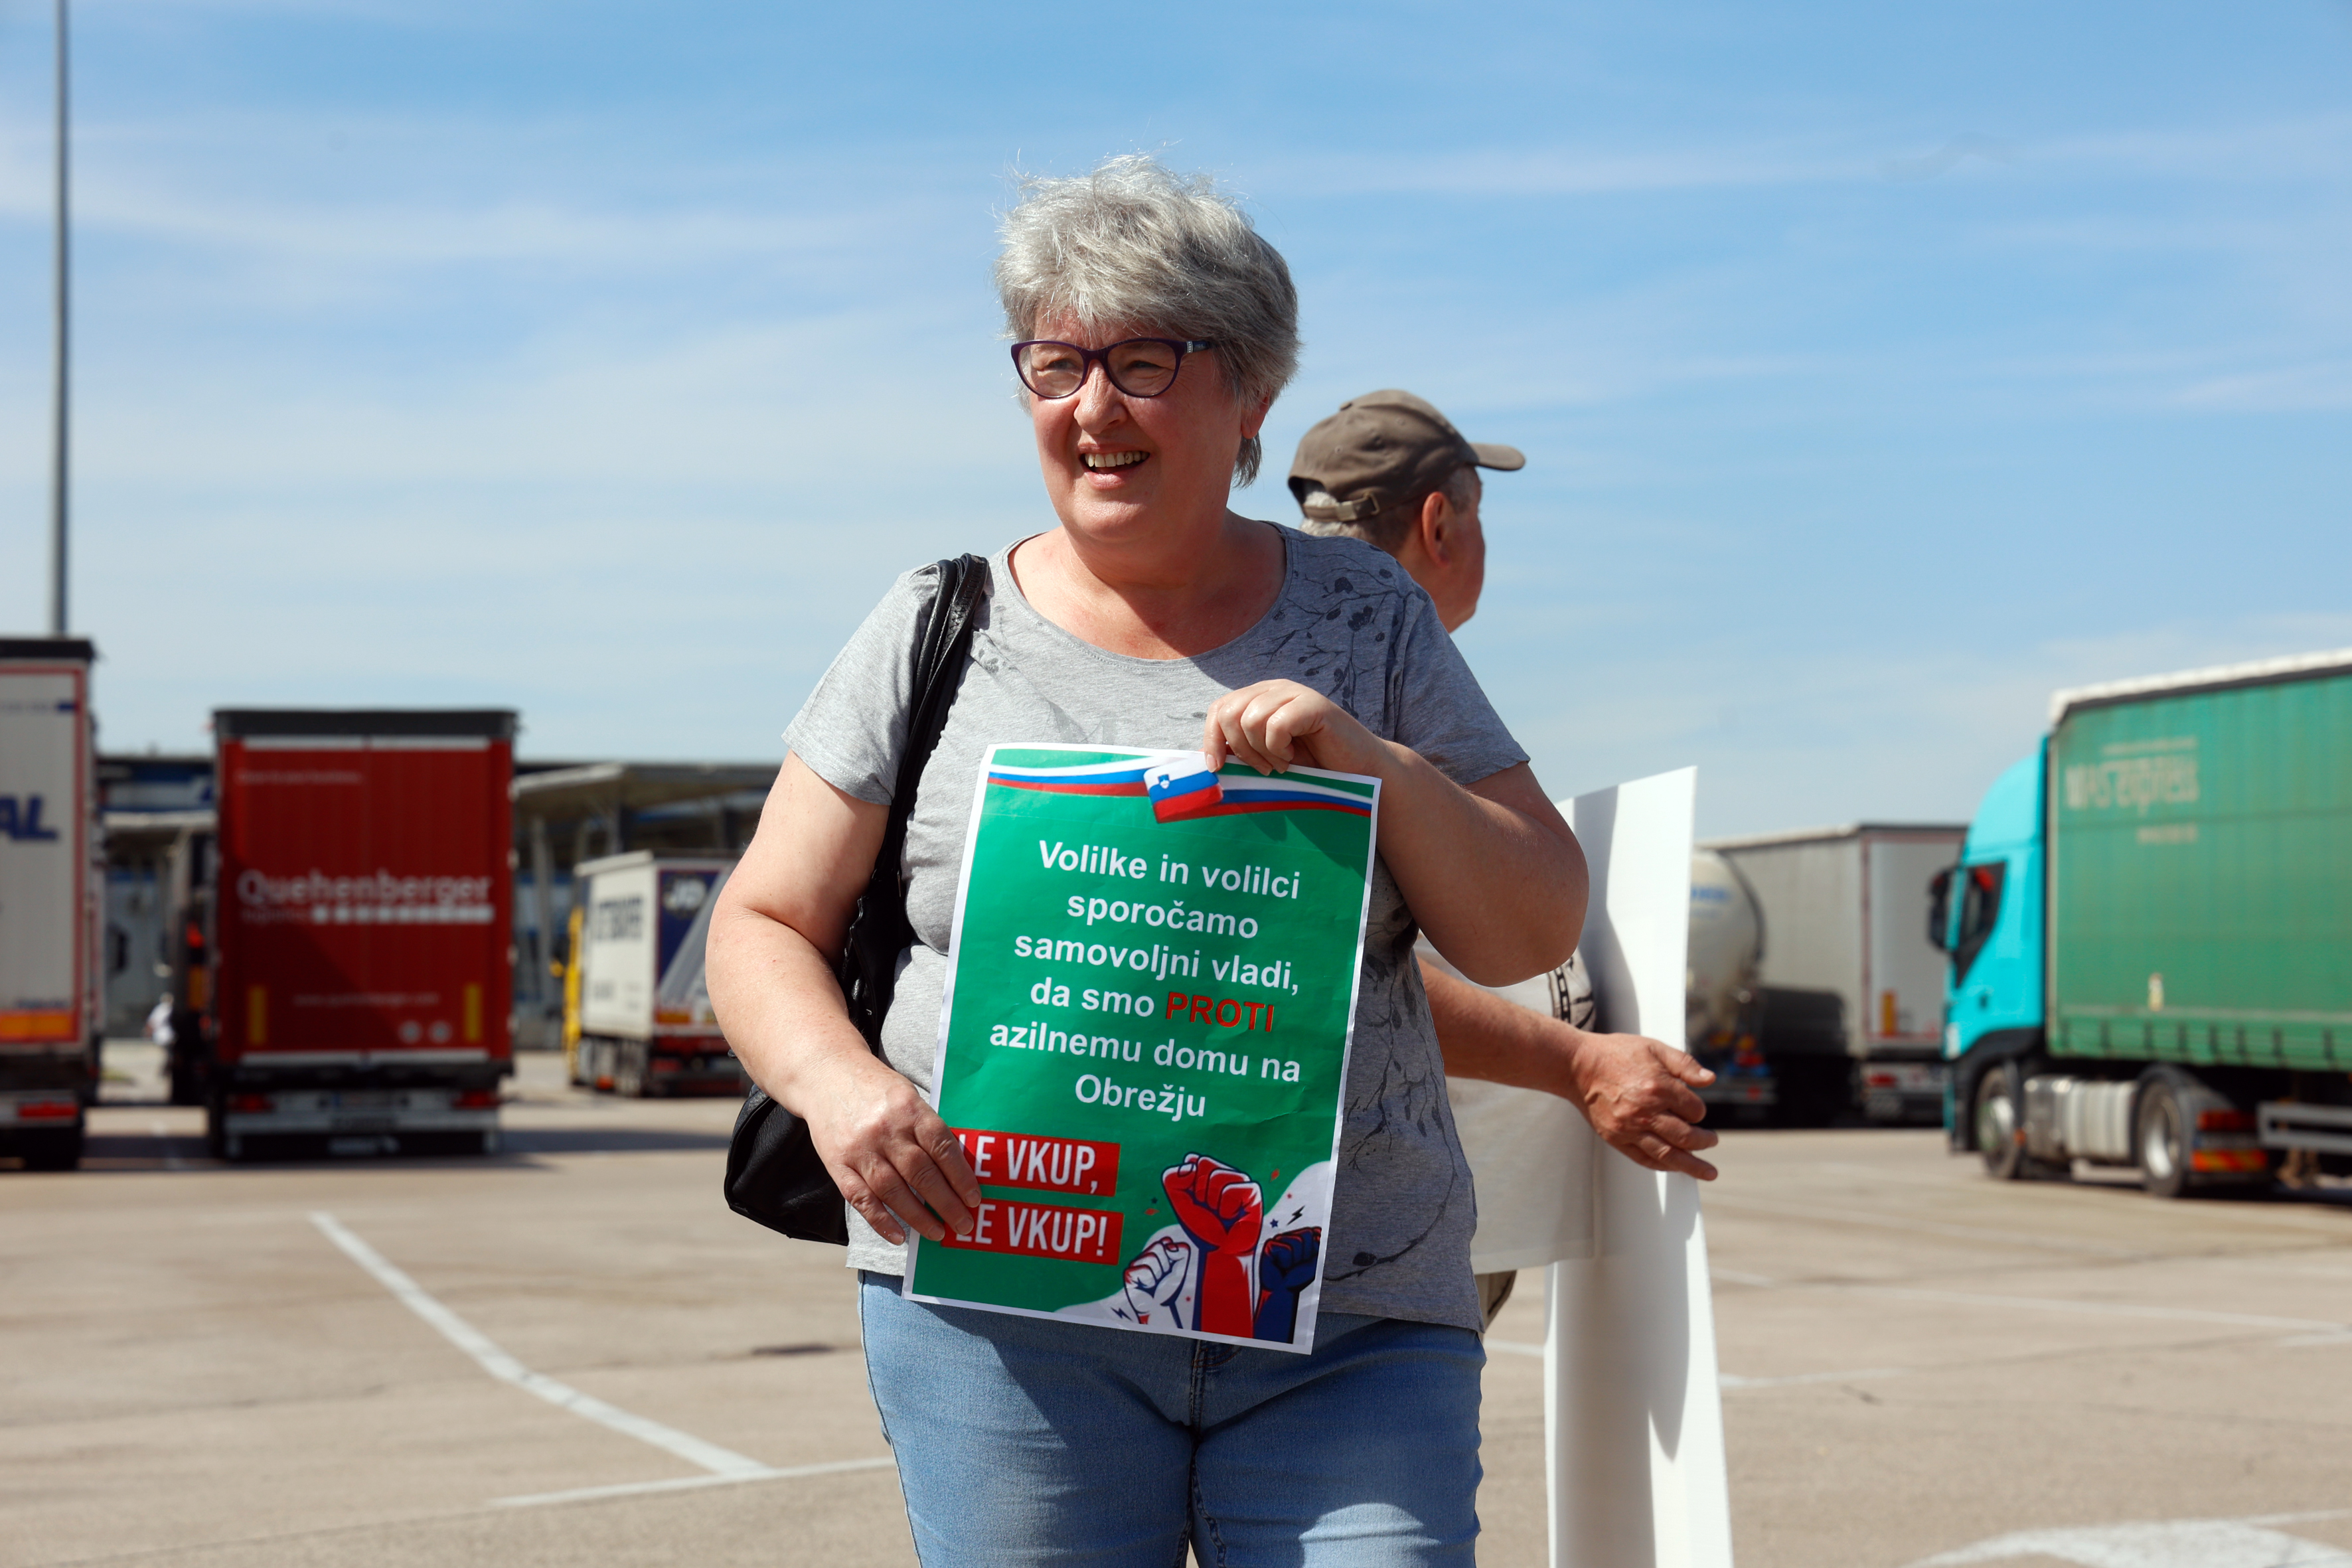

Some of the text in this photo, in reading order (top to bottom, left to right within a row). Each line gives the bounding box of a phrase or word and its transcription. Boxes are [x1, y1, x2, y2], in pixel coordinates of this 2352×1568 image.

[236, 868, 492, 907] Quehenberger
[1039, 840, 1300, 900] Volilke in volilci
[1067, 896, 1258, 939] sporočamo
[1014, 935, 1298, 996] samovoljni vladi,
[1030, 977, 1275, 1032] da smo PROTI
[989, 1021, 1300, 1083] azilnemu domu na
[1075, 1074, 1206, 1122] Obrežju
[1007, 1138, 1099, 1194] VKUP,
[955, 1204, 1108, 1257] E VKUP!
